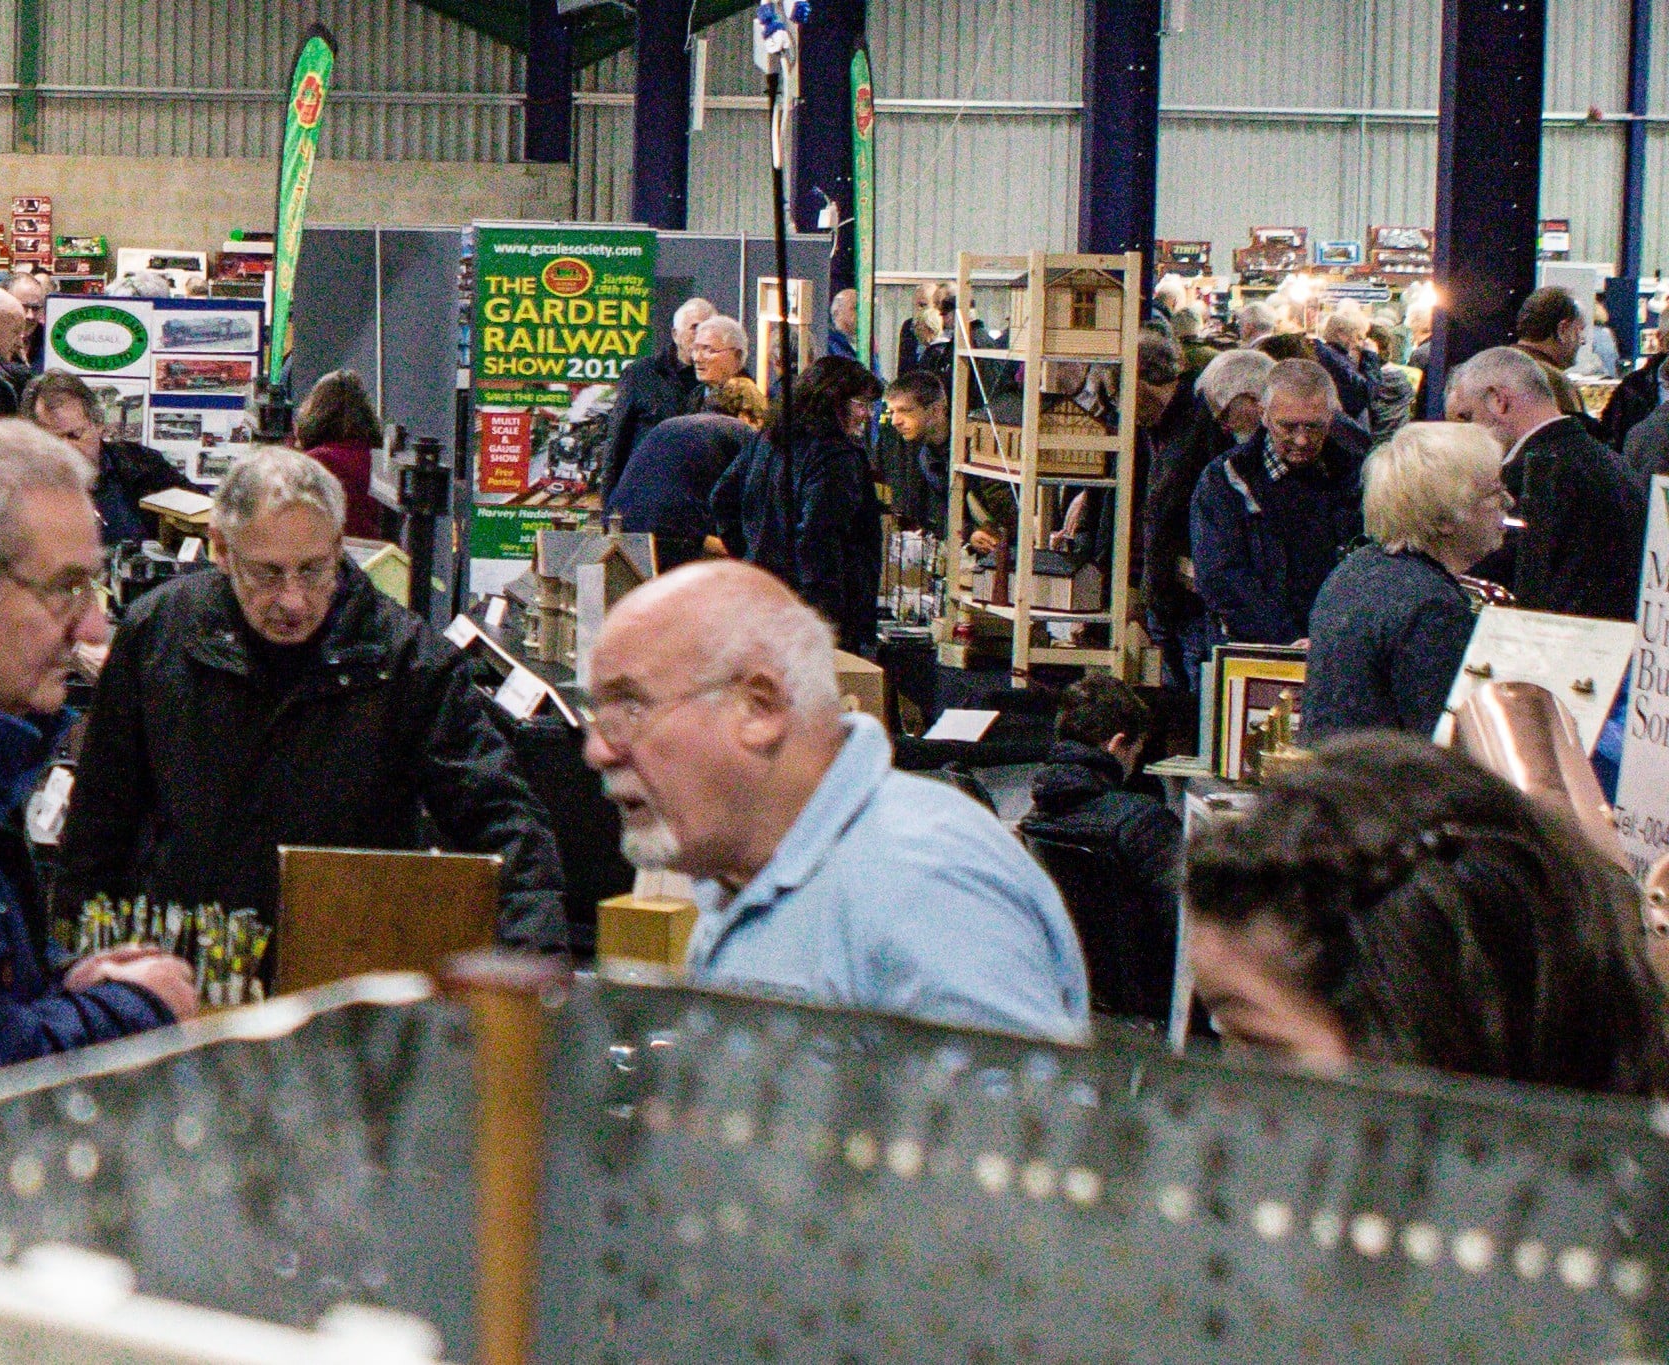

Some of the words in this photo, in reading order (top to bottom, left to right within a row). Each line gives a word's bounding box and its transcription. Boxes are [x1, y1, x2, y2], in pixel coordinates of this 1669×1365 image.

[493, 243, 643, 258] www.gscalesociety.com
[484, 276, 537, 296] THE
[621, 285, 650, 298] May
[483, 297, 650, 326] GARDEN
[483, 325, 648, 356] RAILWAY
[483, 357, 566, 376] SHOW
[514, 393, 534, 403] THE
[491, 417, 521, 426] MULTI
[491, 426, 520, 435] SCALE
[501, 436, 509, 445] &
[489, 445, 522, 455] GAUGE
[489, 454, 520, 464] SHOW
[494, 468, 515, 478] Free
[487, 477, 522, 489] Parking
[477, 508, 516, 520] Harvey
